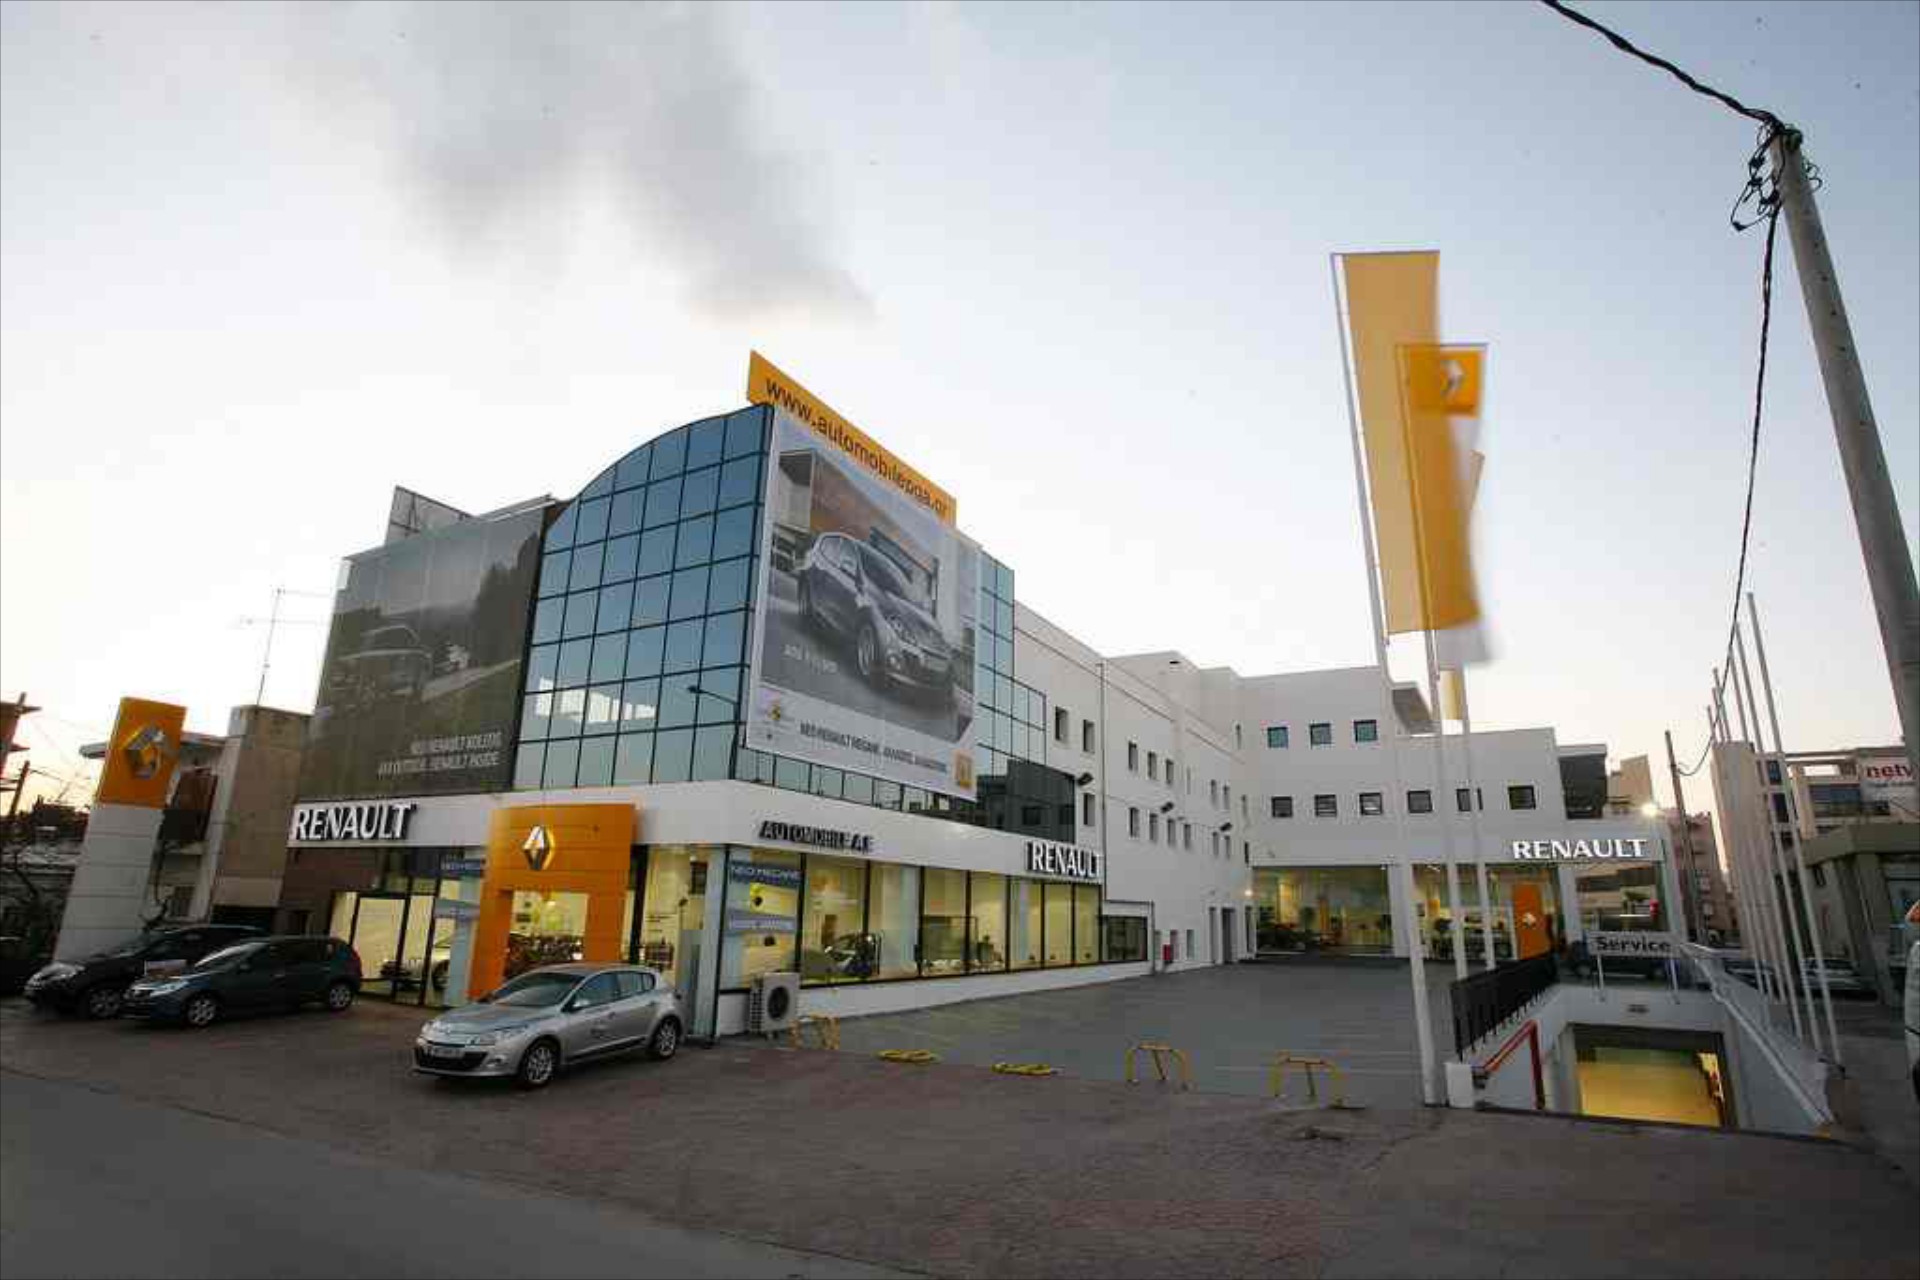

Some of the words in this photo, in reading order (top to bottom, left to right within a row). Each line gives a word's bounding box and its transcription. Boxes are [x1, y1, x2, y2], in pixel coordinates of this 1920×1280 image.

[288, 802, 412, 840] RENAULT
[1030, 840, 1104, 878] RENAULT
[1512, 839, 1647, 860] RENAULT
[1596, 935, 1672, 953] Service
